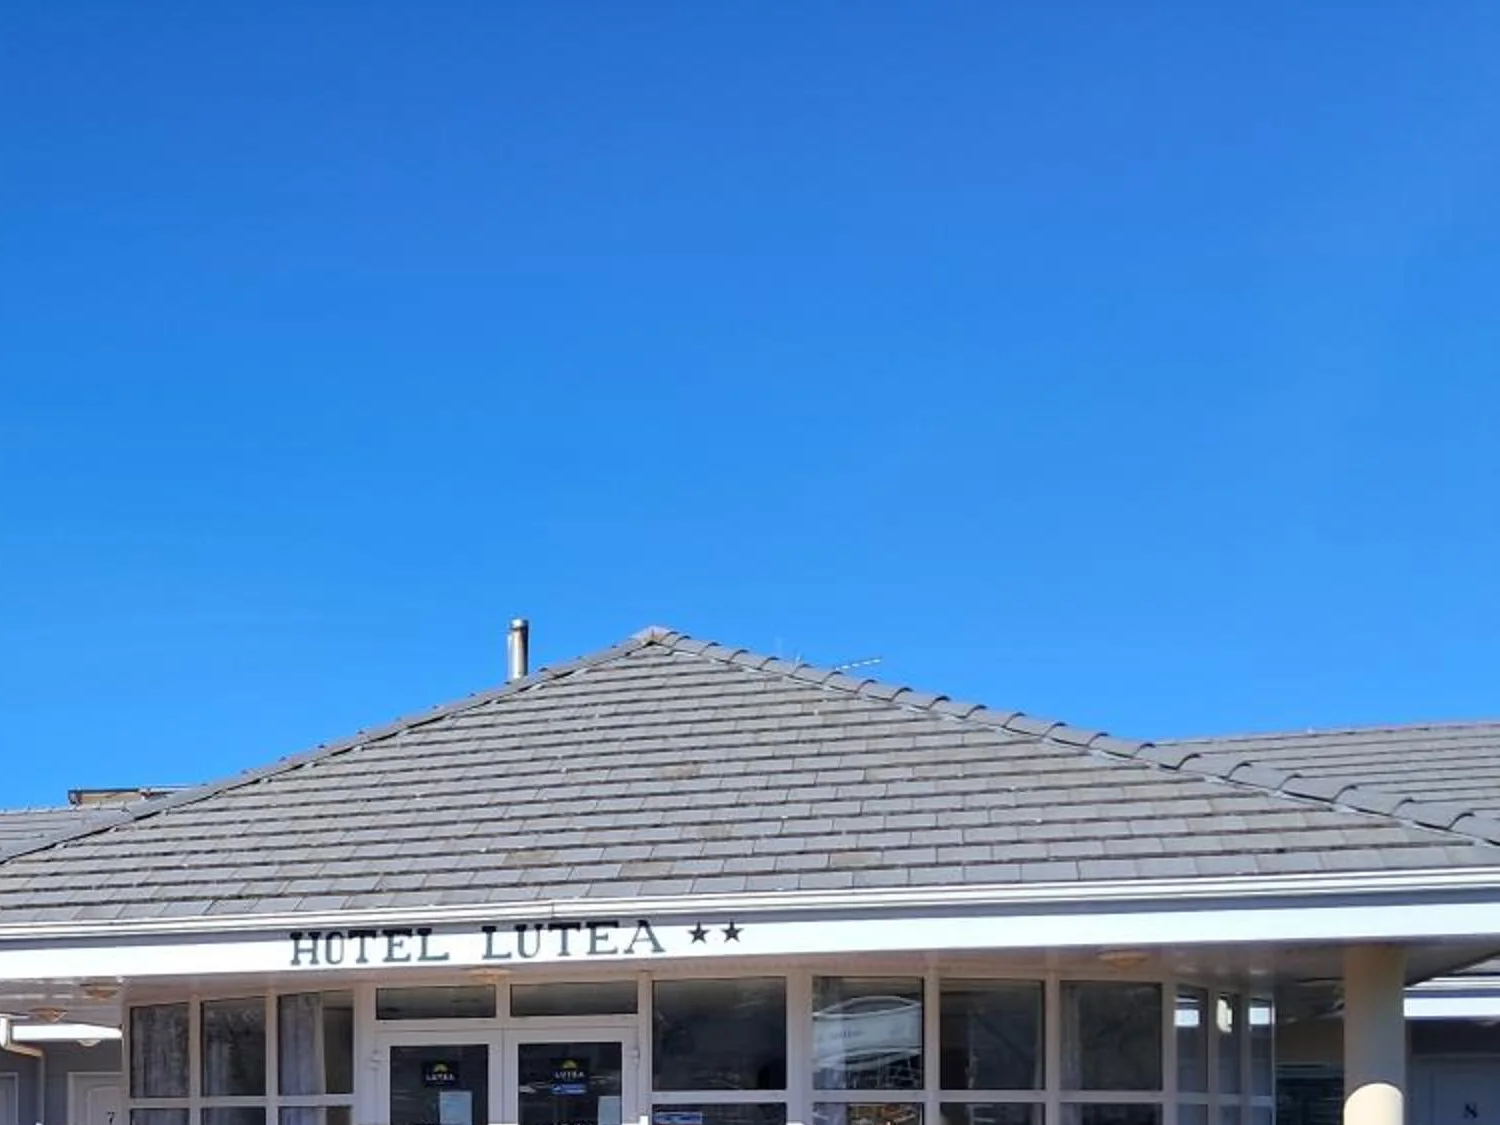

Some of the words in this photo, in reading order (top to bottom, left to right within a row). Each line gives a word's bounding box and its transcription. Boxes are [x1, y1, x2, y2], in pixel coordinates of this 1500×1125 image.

[289, 927, 450, 966] HOTEL
[481, 919, 666, 961] LUTEA
[106, 1111, 116, 1125] 7
